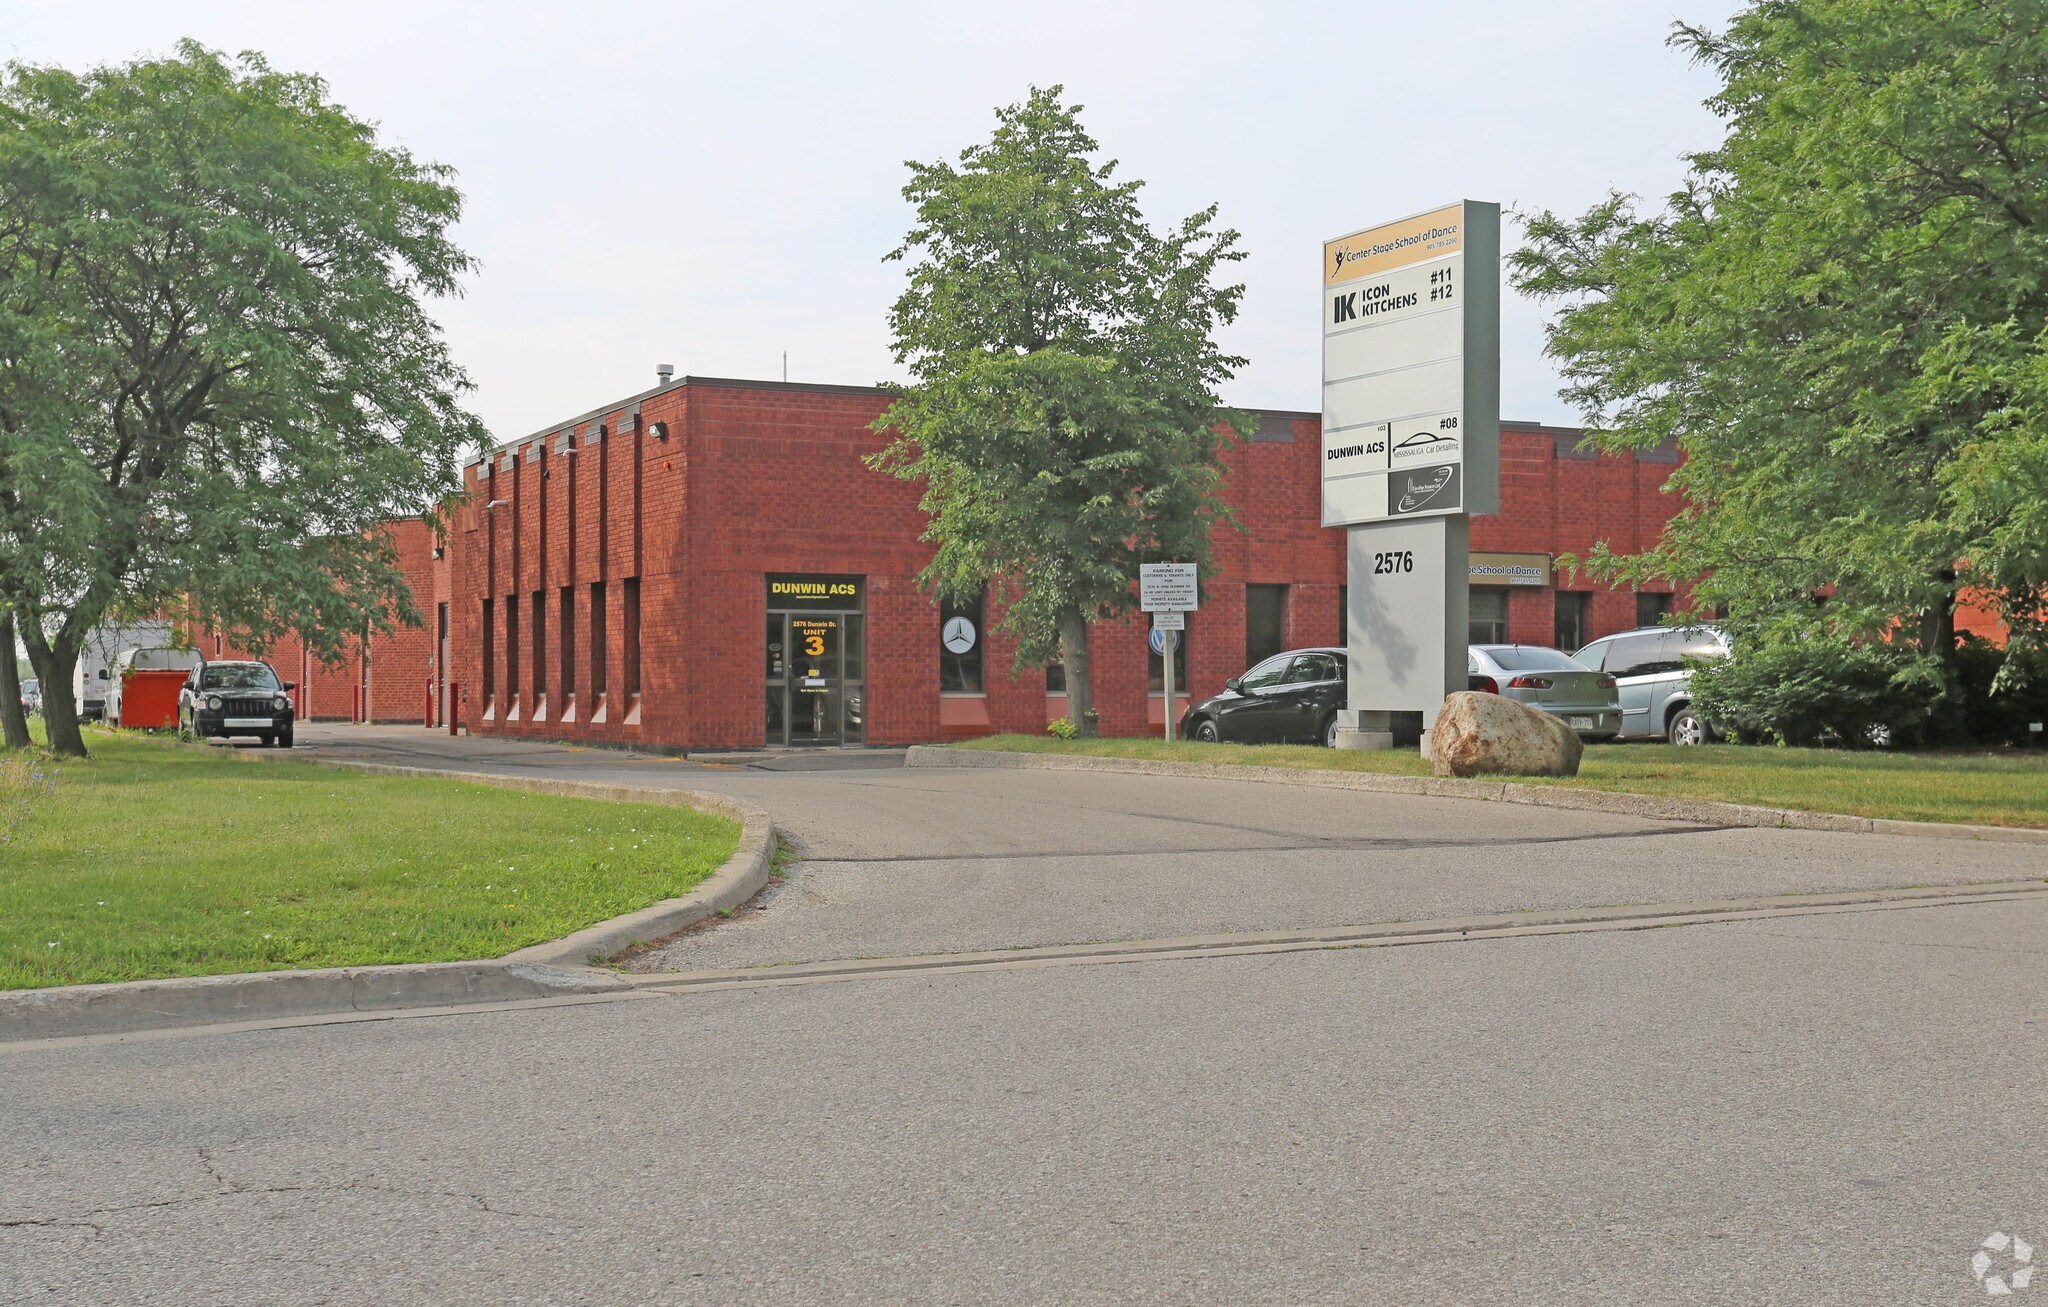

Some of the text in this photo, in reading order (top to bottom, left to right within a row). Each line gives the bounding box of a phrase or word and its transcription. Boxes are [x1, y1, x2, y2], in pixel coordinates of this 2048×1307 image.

[1346, 225, 1457, 262] Center Stage School of Dance
[1430, 267, 1451, 285] #11
[1362, 284, 1390, 302] ICON
[1430, 284, 1453, 302] #12
[1334, 292, 1357, 324] IK
[1362, 292, 1418, 317] KITCHENS
[1440, 417, 1458, 430] #08
[1327, 441, 1385, 460] DUNWIN ACS
[1426, 446, 1435, 454] Car
[1436, 442, 1459, 452] Detailing
[1374, 550, 1413, 575] 2576
[1477, 565, 1505, 575] School
[1506, 565, 1515, 575] of
[1516, 566, 1541, 576] Dance
[772, 583, 856, 595] DUNWIN ACS
[805, 636, 825, 656] 3
